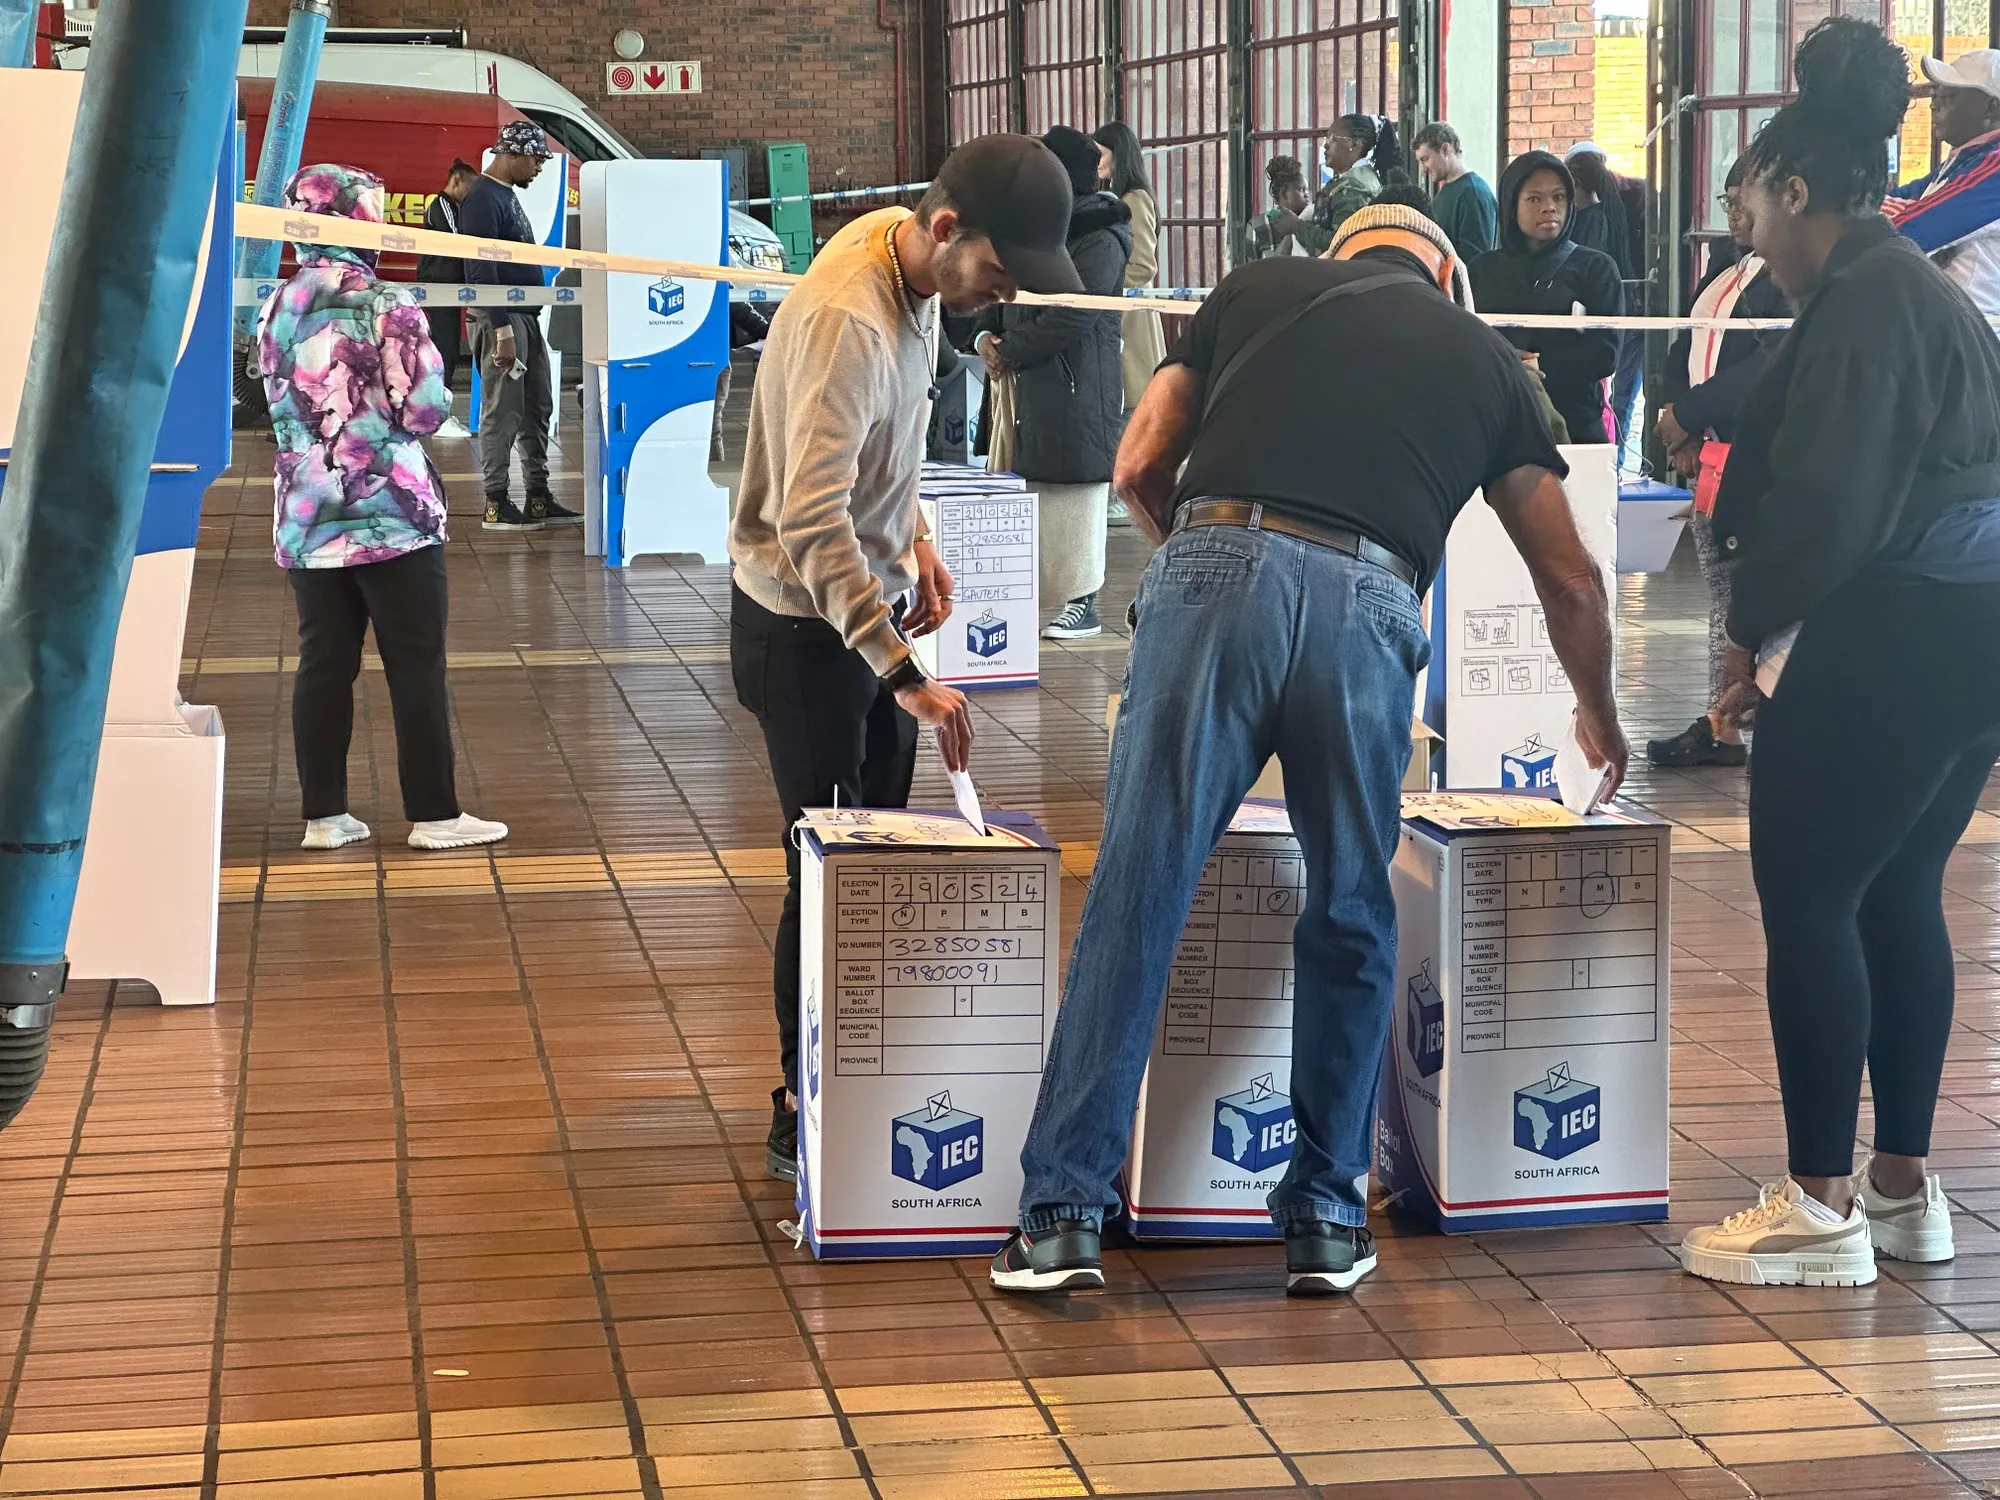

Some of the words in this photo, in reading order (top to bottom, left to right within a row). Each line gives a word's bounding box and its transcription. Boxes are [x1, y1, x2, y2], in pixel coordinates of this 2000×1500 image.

[668, 293, 682, 308] IEC
[988, 629, 1006, 648] IEC
[1466, 860, 1502, 869] ELECTION
[1474, 870, 1494, 878] DATE
[1466, 888, 1502, 898] ELECTION
[1522, 888, 1528, 896] N
[900, 910, 908, 918] N
[940, 910, 948, 918] P
[980, 909, 988, 918] M
[1021, 909, 1028, 917] B
[1474, 920, 1505, 928] NUMBER
[850, 941, 882, 949] NUMBER
[889, 937, 1021, 958] 32850581
[887, 962, 998, 984] 79800091
[1170, 986, 1211, 994] SEQUENCE
[1465, 984, 1503, 992] SEQUENCE
[1170, 1002, 1208, 1010] MUNICIPAL
[1465, 1000, 1502, 1008] MUNICIPAL
[839, 1023, 880, 1031] MUNICIPAL
[1426, 1020, 1443, 1054] IEC
[1466, 1032, 1501, 1041] PROVINCE
[840, 1056, 878, 1064] PROVINCE
[1561, 1104, 1596, 1140] IEC
[1261, 1118, 1297, 1152] IEC
[1380, 1118, 1400, 1156] Ballot
[942, 1134, 979, 1170] IEC
[1380, 1145, 1394, 1176] Box
[1514, 1168, 1554, 1180] SOUTH
[1556, 1165, 1600, 1178] AFRICA
[1210, 1179, 1251, 1190] SOUTH
[1253, 1180, 1280, 1190] AFR
[891, 1198, 934, 1209] SOUTH
[936, 1198, 982, 1208] AFRICA
